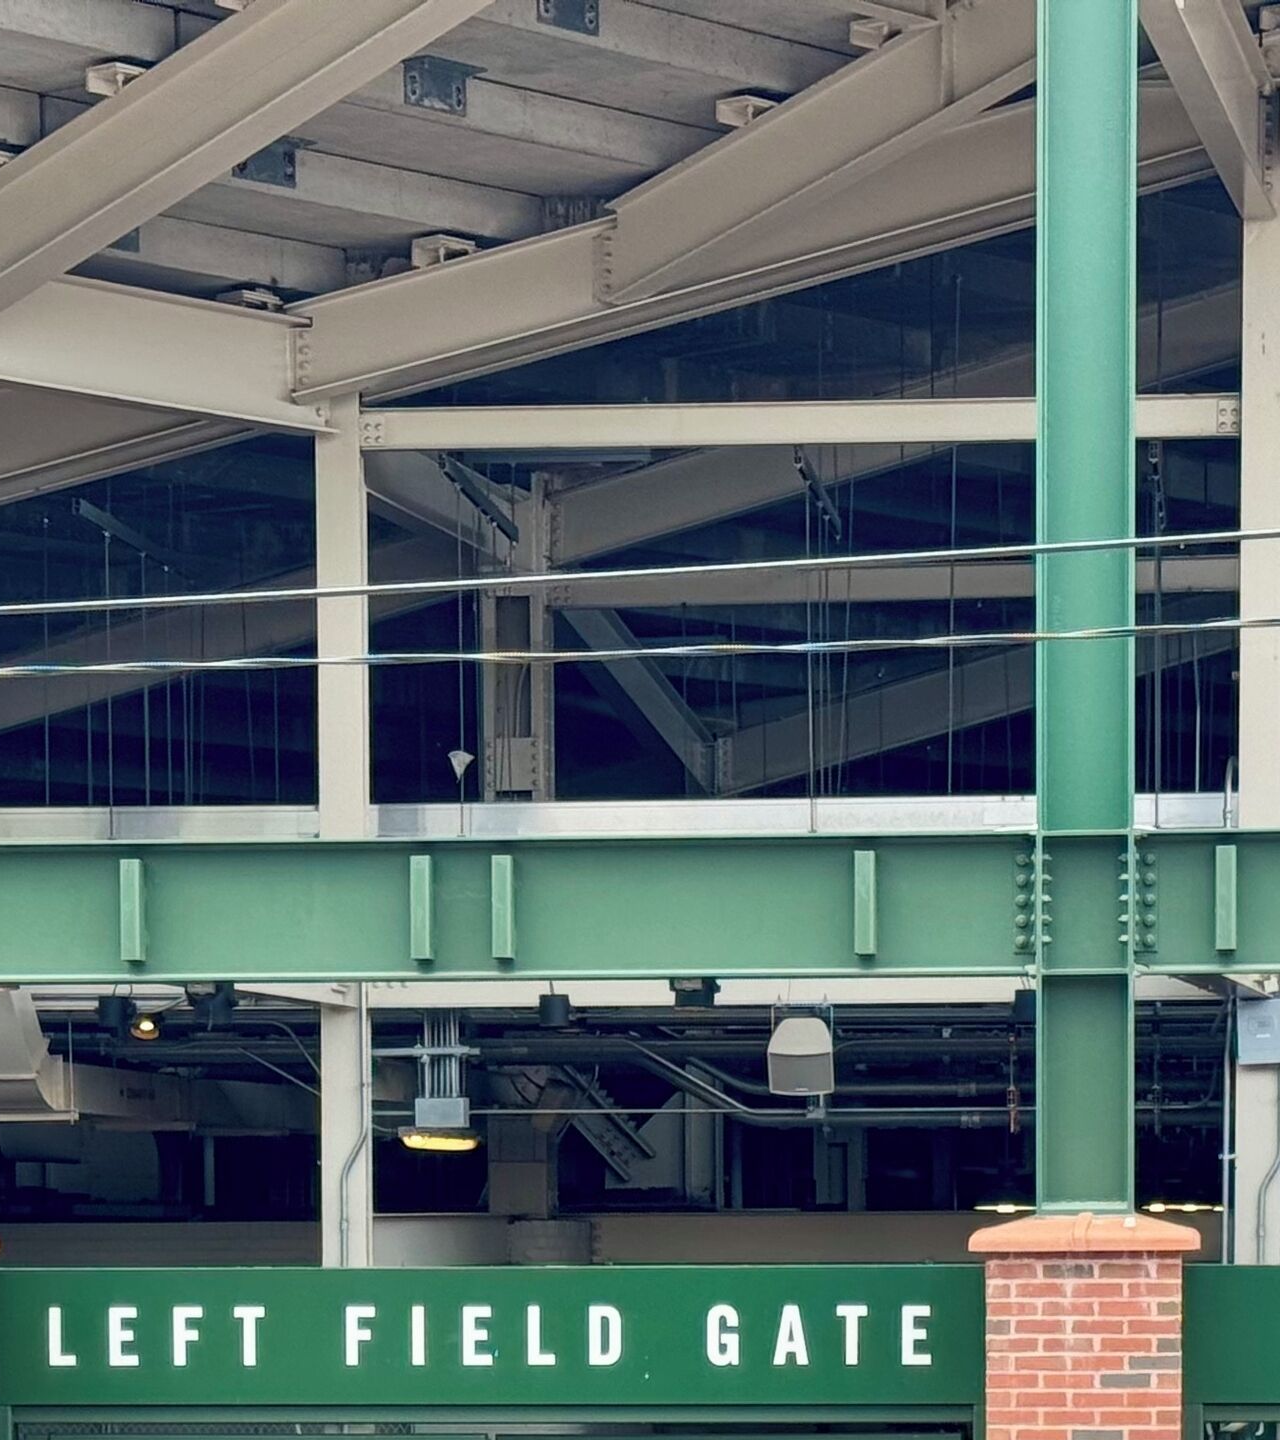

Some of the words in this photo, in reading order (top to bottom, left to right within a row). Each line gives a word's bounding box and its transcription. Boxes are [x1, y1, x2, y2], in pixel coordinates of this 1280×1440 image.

[48, 1305, 267, 1367] LEFT
[344, 1305, 623, 1367] FIELD
[705, 1304, 933, 1366] GATE
